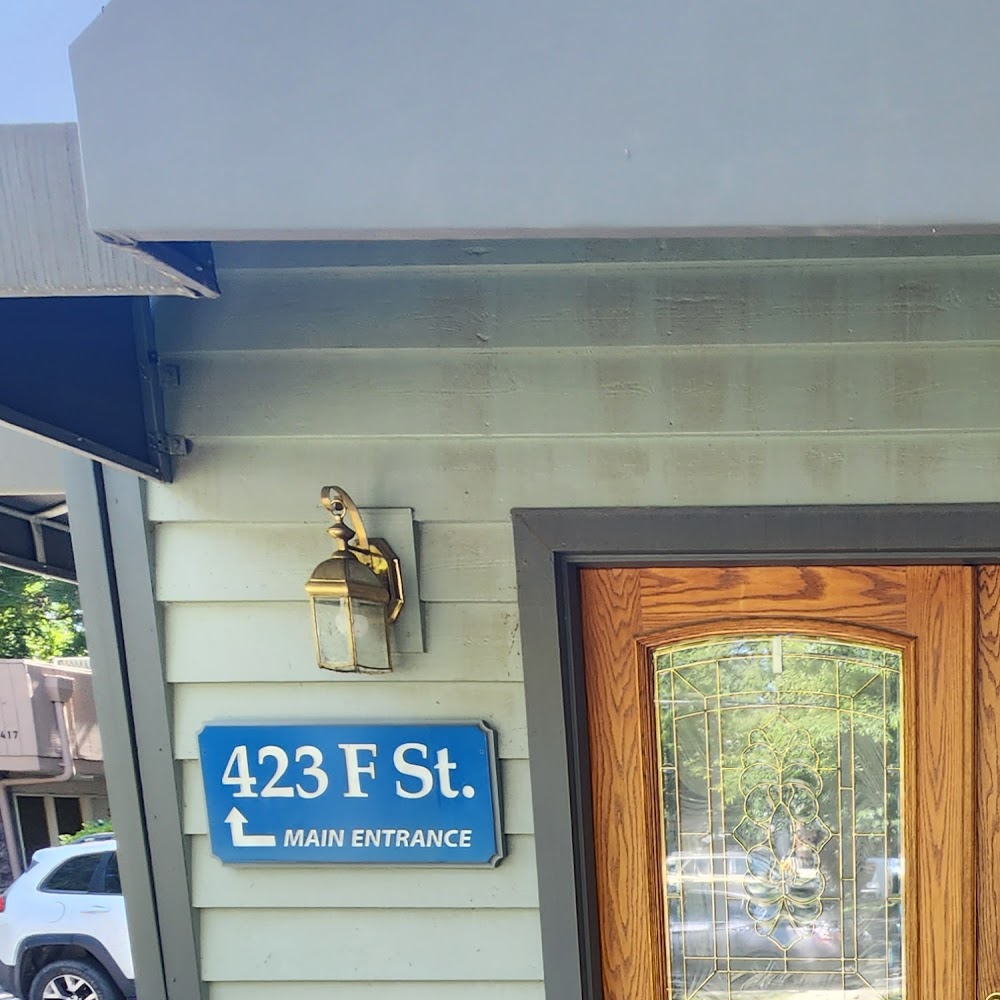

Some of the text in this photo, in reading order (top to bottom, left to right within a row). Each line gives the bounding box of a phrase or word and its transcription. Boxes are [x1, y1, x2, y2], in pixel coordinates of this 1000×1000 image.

[221, 742, 475, 799] 423 F St.
[283, 829, 472, 848] MAIN ENTRANCE
